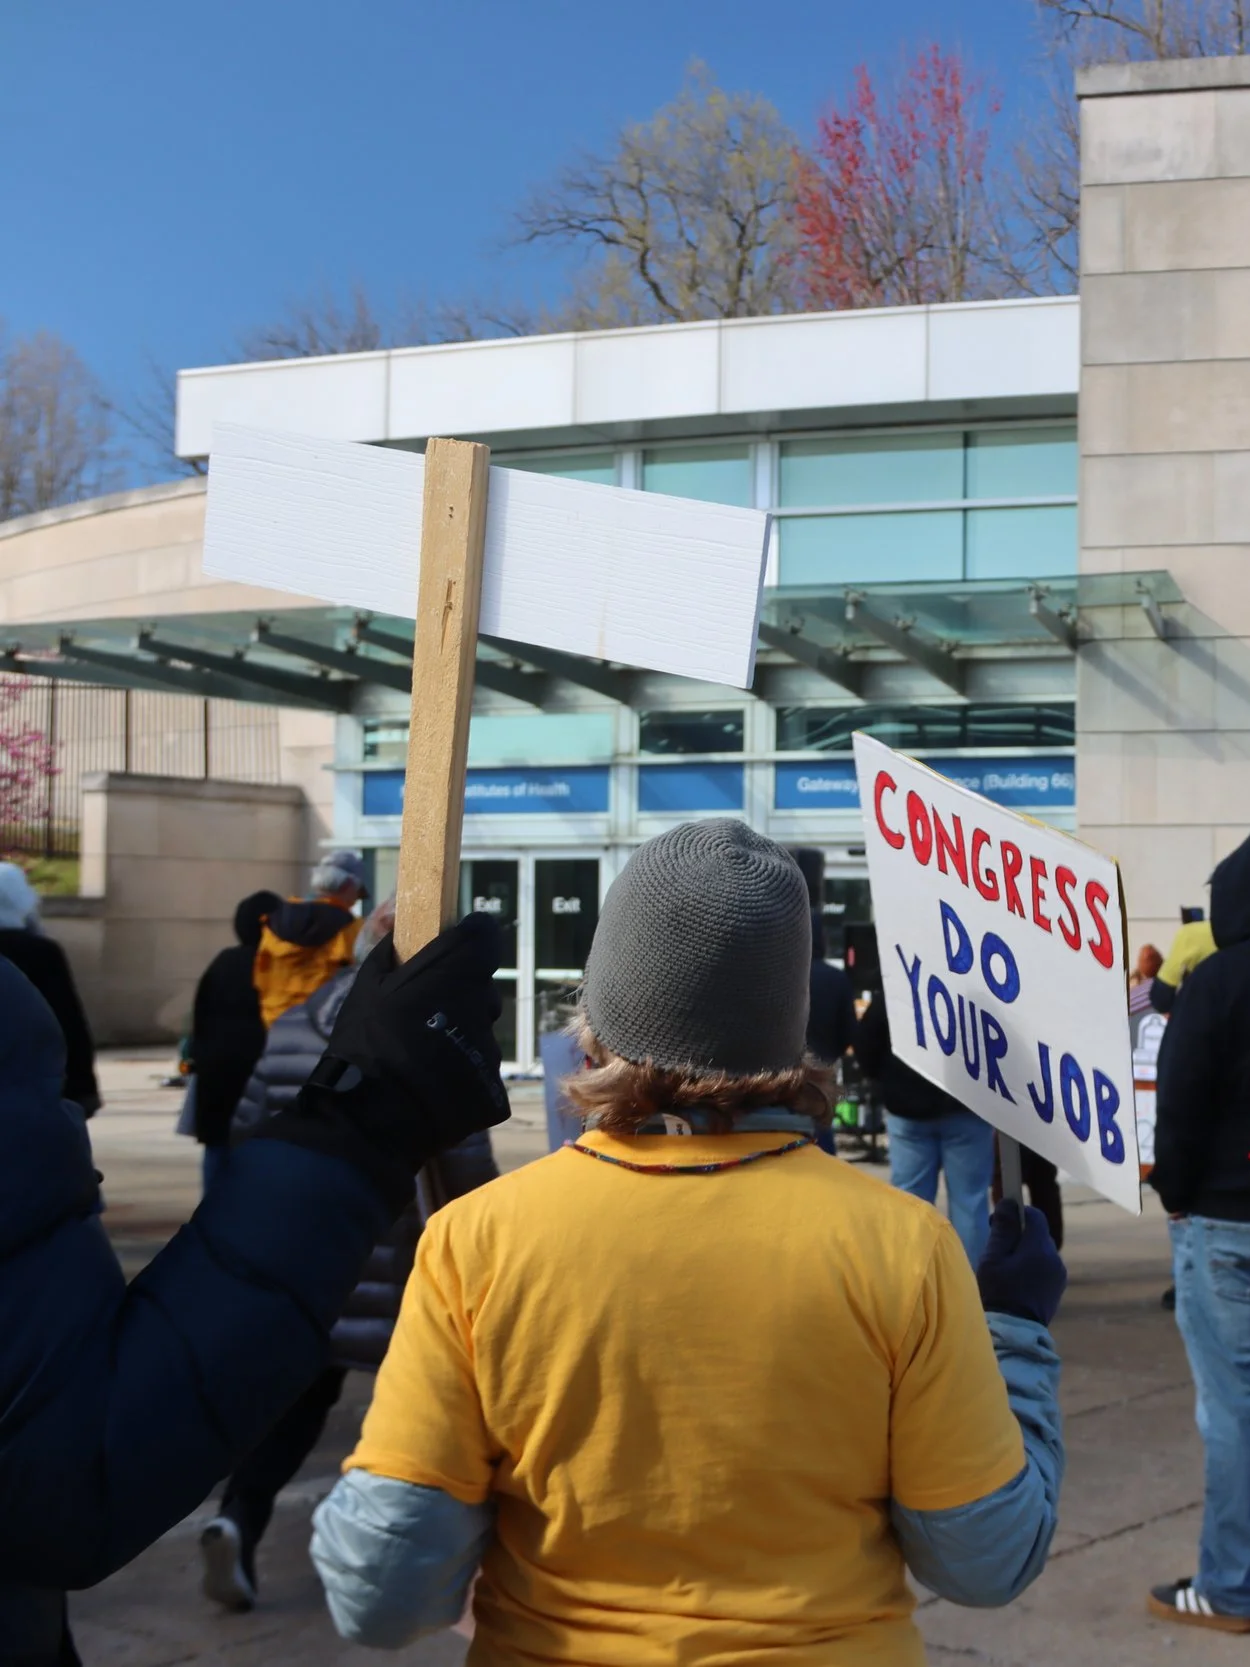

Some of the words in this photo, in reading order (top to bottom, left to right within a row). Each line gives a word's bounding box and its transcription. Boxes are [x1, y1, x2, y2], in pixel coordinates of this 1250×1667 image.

[514, 783, 528, 797] of
[529, 782, 570, 797] Health
[797, 777, 859, 794] Gateway
[983, 774, 1049, 792] (Building
[873, 770, 1114, 969] CONGRESS
[474, 896, 501, 912] Exit
[552, 896, 580, 913] Exit
[823, 903, 846, 914] nter
[939, 899, 1020, 1003] DO
[895, 943, 1018, 1106] YOUR
[1027, 1042, 1126, 1165] JOB
